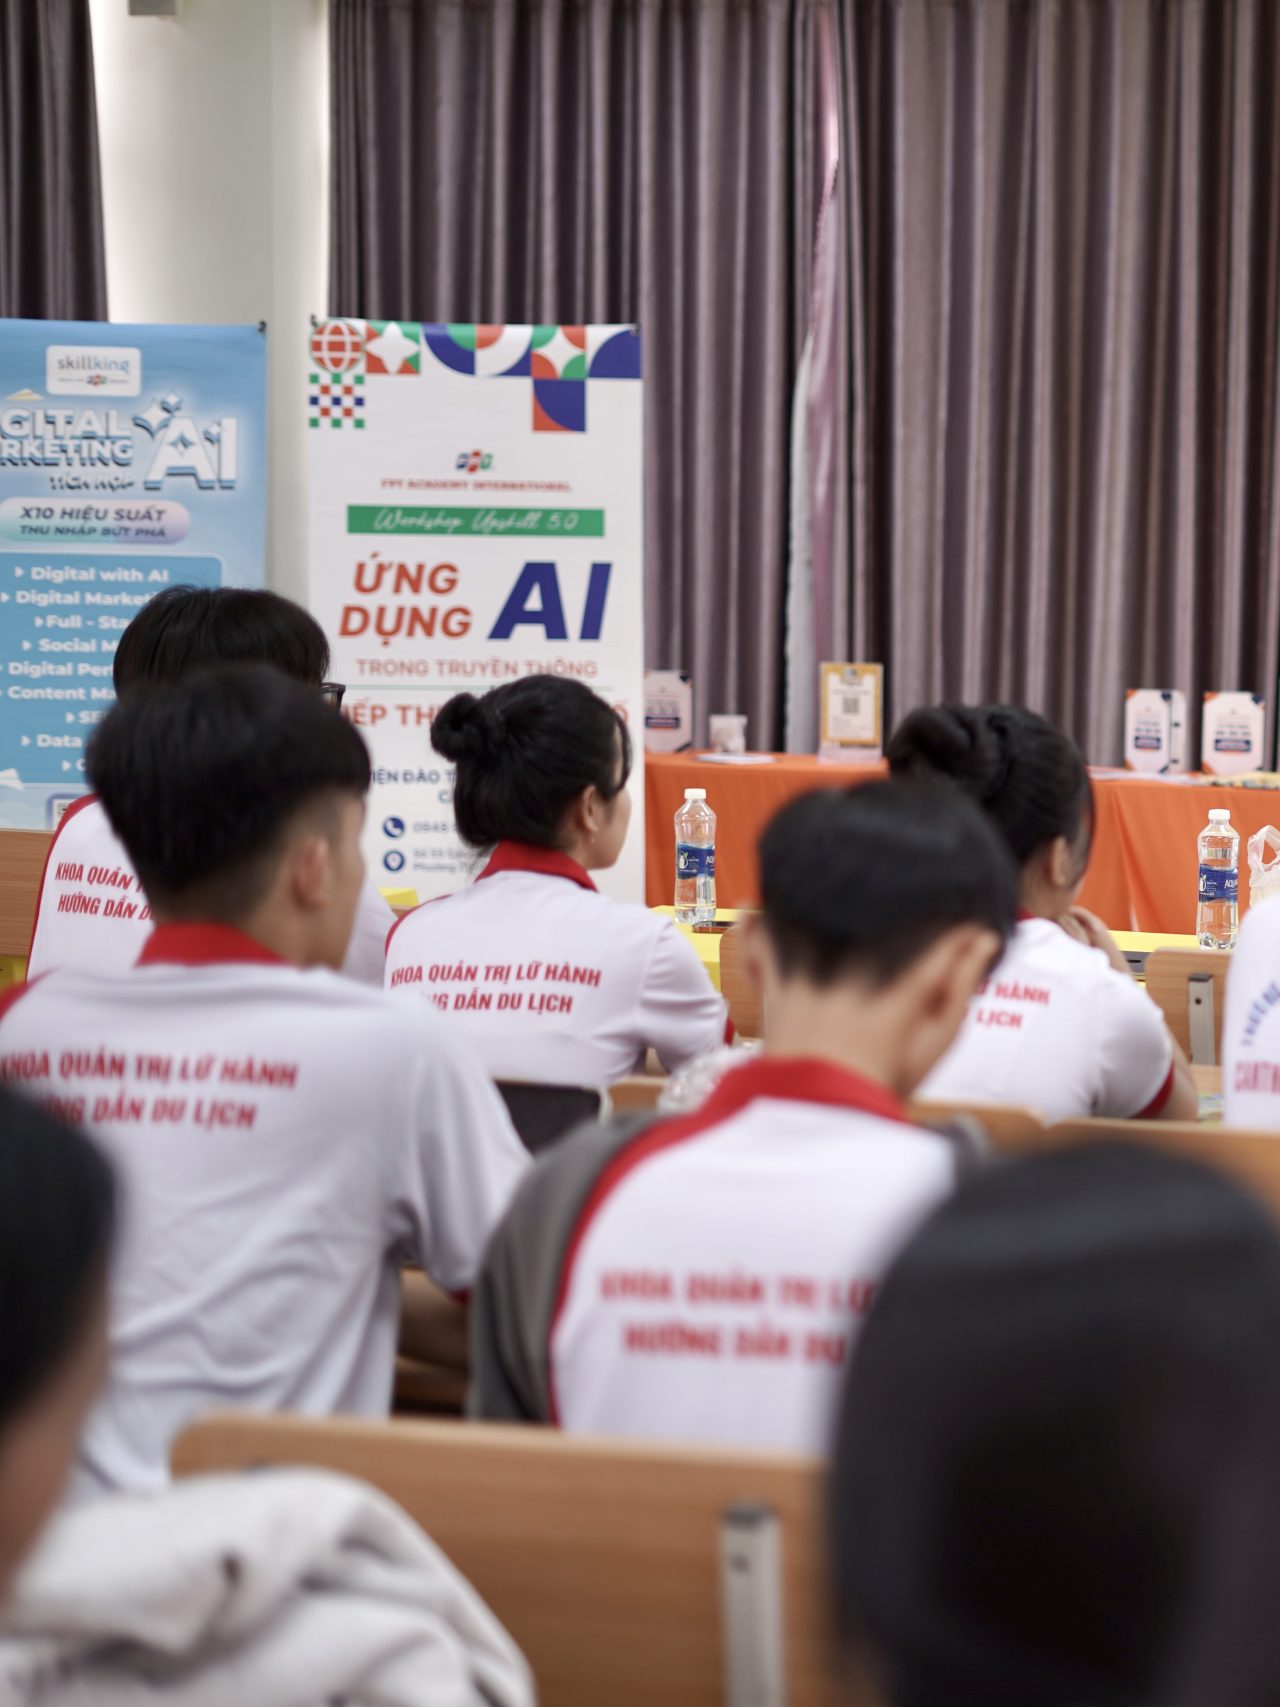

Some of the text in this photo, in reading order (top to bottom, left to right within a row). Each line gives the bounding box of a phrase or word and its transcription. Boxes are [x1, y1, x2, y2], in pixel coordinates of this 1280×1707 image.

[57, 355, 129, 374] skillking
[0, 409, 131, 439] GITAL
[0, 440, 133, 466] RKETING
[144, 416, 238, 490] AI
[20, 506, 54, 520] X10
[60, 505, 108, 523] HIỆU
[374, 508, 464, 534] Workshop
[472, 509, 542, 534] Upskill
[31, 566, 170, 584] Digital with AI
[353, 551, 459, 595] ỨNG
[15, 590, 80, 607] Digital
[487, 559, 613, 641] AI
[46, 614, 81, 629] Full
[98, 614, 132, 630] Sta
[338, 604, 472, 648] DỤNG
[38, 638, 97, 653] Social
[8, 662, 73, 679] Digital
[356, 658, 429, 677] TRONG
[8, 686, 85, 700] Content
[37, 734, 82, 748] Data
[372, 767, 398, 785] IỆN
[55, 862, 84, 881] KHOA
[86, 866, 134, 890] QUẢN
[57, 891, 101, 915] HƯỚNG
[390, 964, 423, 988] KHOA
[428, 960, 479, 982] QUẢN
[484, 964, 511, 984] TRỊ
[544, 961, 602, 987] HÀNH
[496, 992, 523, 1011] DU
[527, 992, 575, 1015] LỊCH
[219, 1054, 299, 1090] HÀNH
[151, 1096, 187, 1126] DU
[192, 1096, 258, 1131] LỊCH
